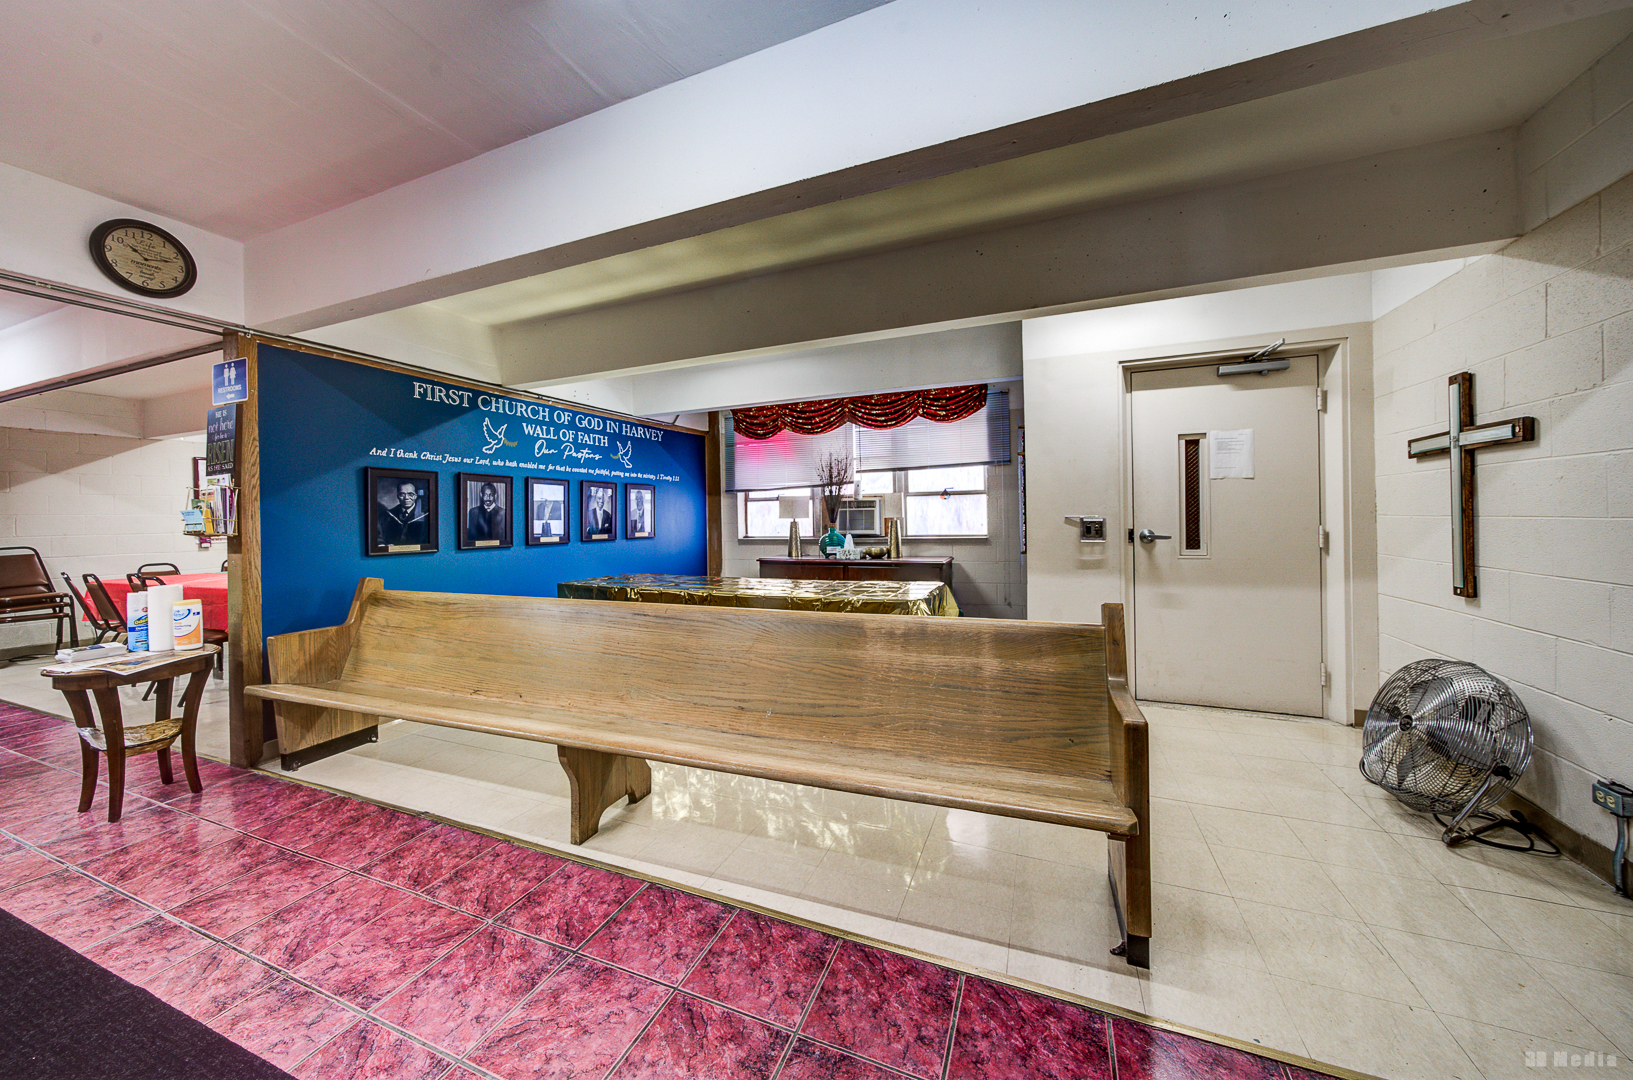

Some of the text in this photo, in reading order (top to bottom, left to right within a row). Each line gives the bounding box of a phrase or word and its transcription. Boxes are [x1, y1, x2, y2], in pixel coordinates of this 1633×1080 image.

[111, 234, 124, 244] 10
[124, 230, 136, 238] 11
[140, 230, 154, 241] 12
[104, 244, 112, 252] 9
[172, 252, 180, 260] 2
[111, 258, 118, 267] 8
[126, 271, 133, 279] 7
[172, 276, 178, 284] 4
[158, 280, 166, 288] 5
[217, 384, 242, 394] RESTROOMS
[413, 382, 664, 442] FIRST CHURCH OF GOD IN HARVEY
[208, 417, 234, 433] not here
[522, 422, 608, 447] WALL OF FAITH
[207, 439, 234, 465] RISEN
[534, 439, 602, 463] Our Pastors
[369, 447, 387, 457] And
[389, 448, 395, 457] I
[396, 449, 418, 459] thank
[420, 451, 442, 461] Christ
[442, 454, 462, 464] Jesus
[475, 456, 490, 466] Lord,
[222, 462, 234, 470] SAID
